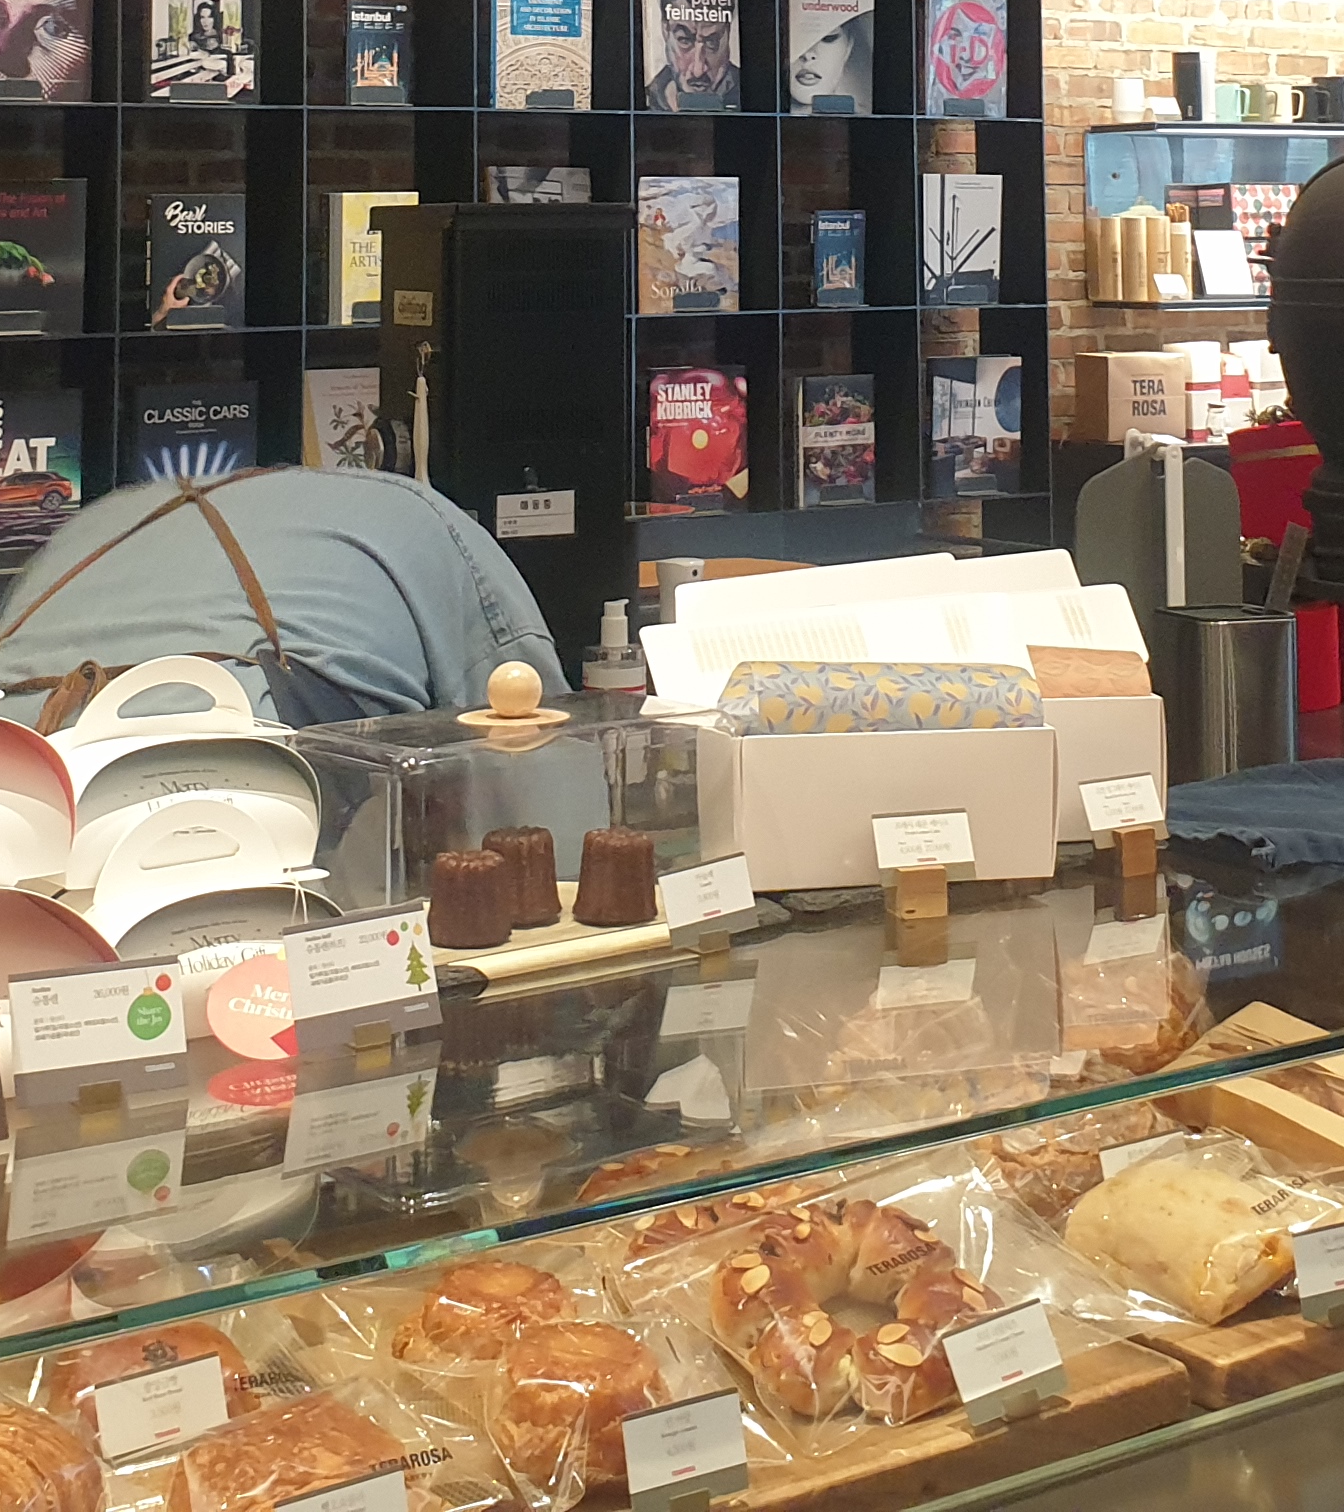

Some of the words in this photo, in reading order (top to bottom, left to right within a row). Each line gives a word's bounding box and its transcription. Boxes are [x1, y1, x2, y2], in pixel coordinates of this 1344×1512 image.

[665, 3, 733, 23] feinstein
[801, 0, 859, 13] underwood
[351, 11, 392, 23] Istanbul
[164, 200, 208, 227] Bowl
[177, 221, 235, 234] STORIES
[349, 241, 378, 254] THE
[656, 383, 713, 402] STANLEY
[1131, 379, 1165, 397] TERA
[143, 407, 207, 424] CLASSIC
[209, 404, 250, 421] CARS
[657, 401, 713, 421] KUBRICK
[1132, 399, 1167, 417] ROSA
[179, 950, 236, 976] Holiday
[865, 1242, 937, 1277] TERAROSA
